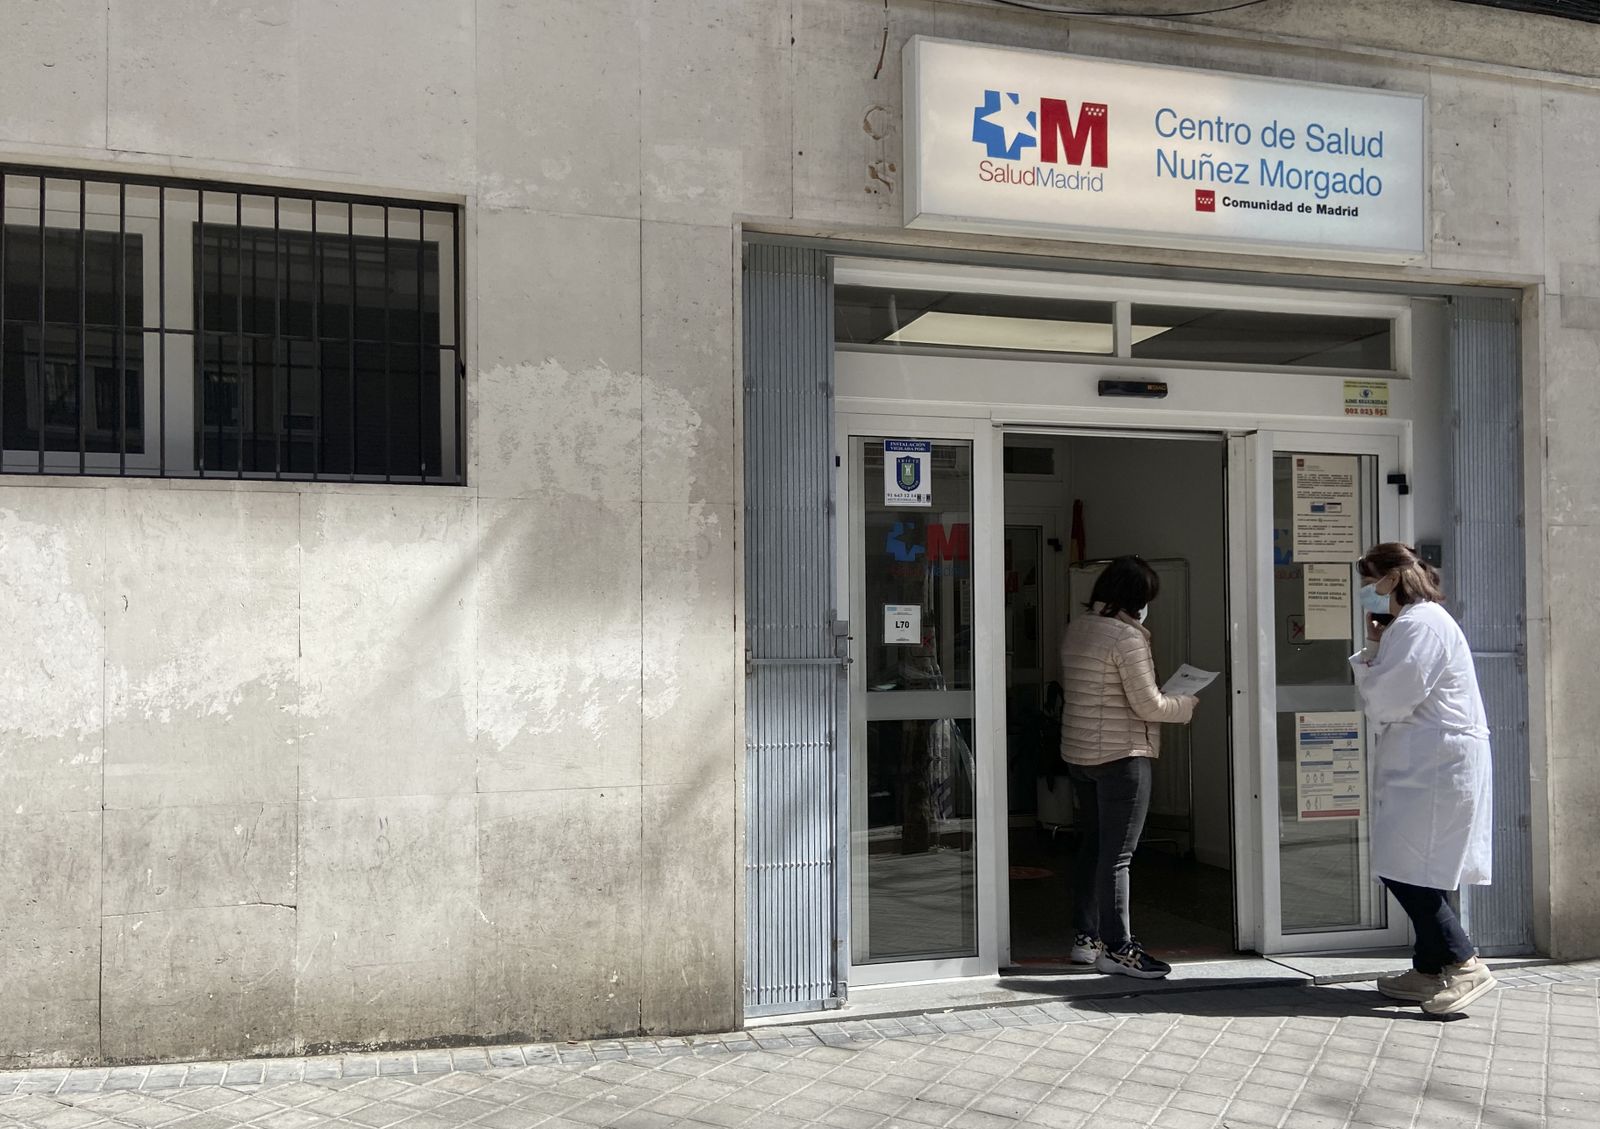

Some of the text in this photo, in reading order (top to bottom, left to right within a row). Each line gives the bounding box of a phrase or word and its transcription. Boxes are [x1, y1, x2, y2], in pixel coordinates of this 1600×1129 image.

[1040, 97, 1108, 168] M
[1155, 108, 1384, 158] Centro de Salud
[979, 160, 1104, 192] SaludMadrid
[1156, 148, 1382, 199] Nuñez Morgado
[1222, 197, 1359, 217] Comunidad de Madrid
[896, 620, 910, 629] L70
